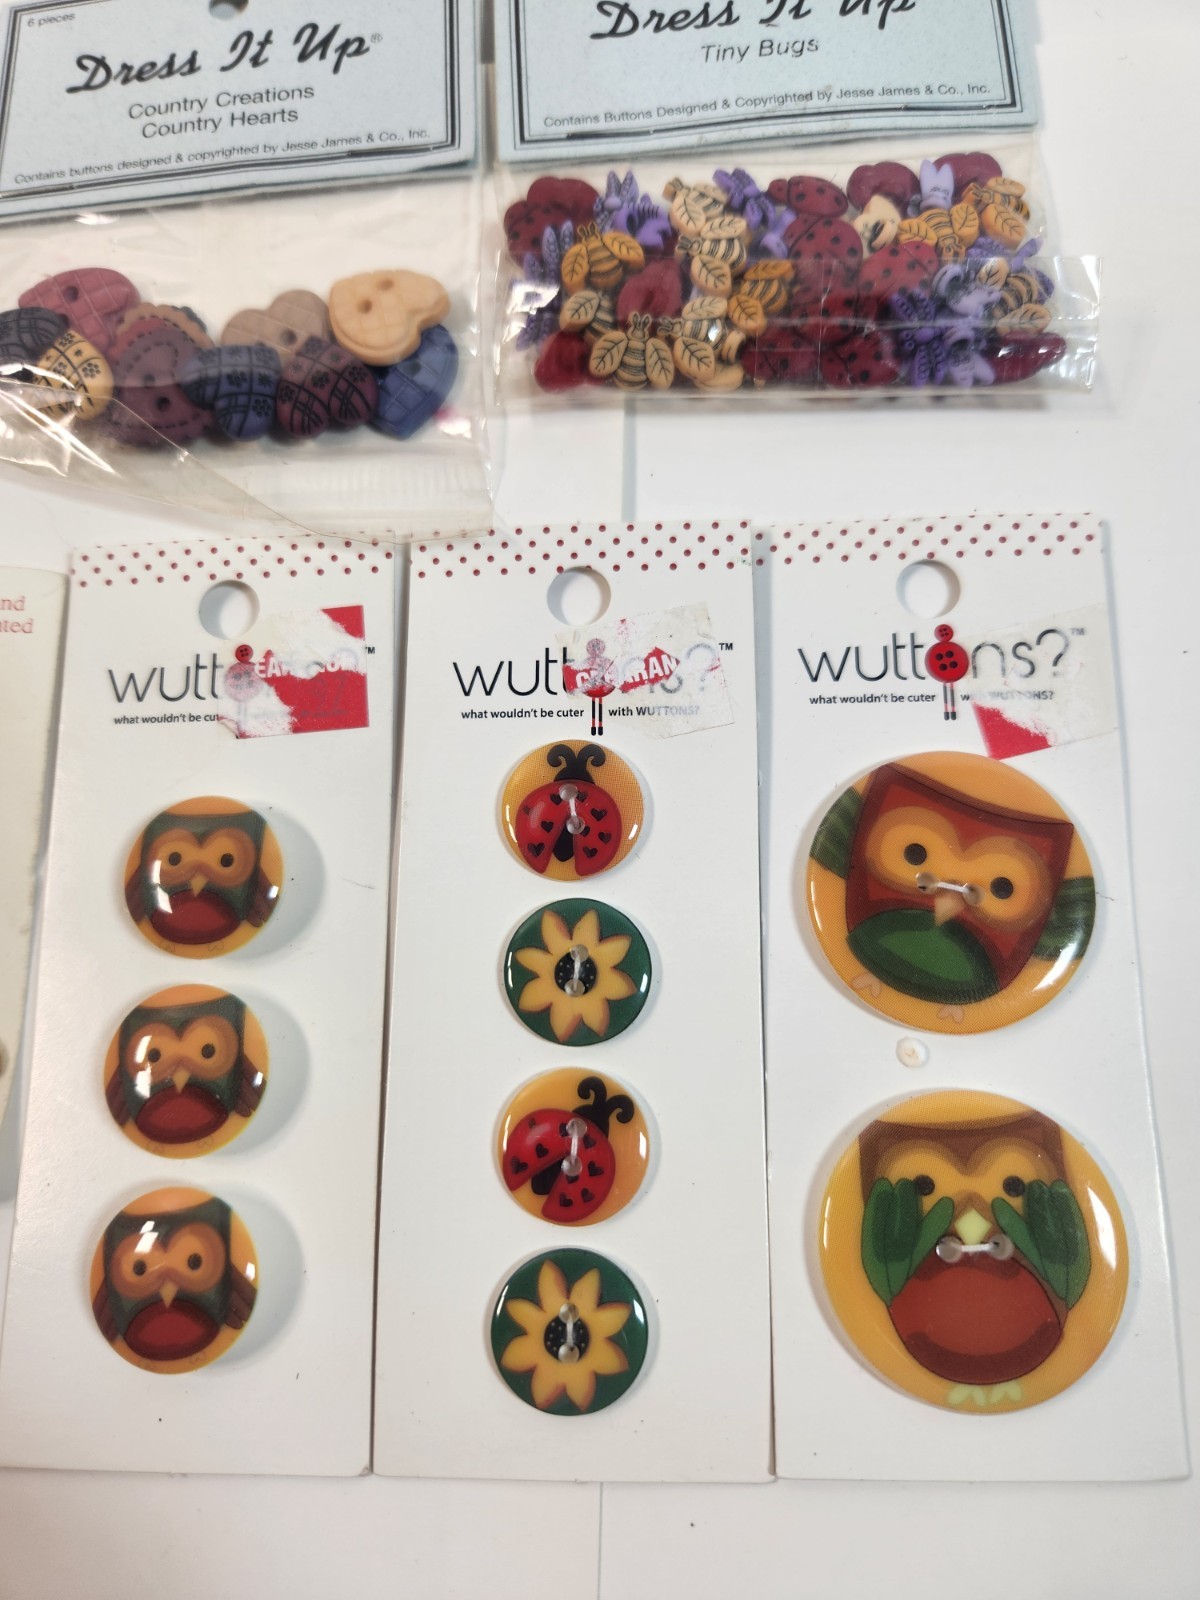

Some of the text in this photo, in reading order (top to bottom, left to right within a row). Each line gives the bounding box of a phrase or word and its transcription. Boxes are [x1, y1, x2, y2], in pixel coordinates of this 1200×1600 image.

[27, 12, 76, 27] 6 pieces
[589, 0, 740, 40] Dress
[66, 50, 201, 94] Dress
[219, 29, 273, 72] It
[700, 38, 819, 64] Tiny Bugs
[128, 86, 315, 120] Country Creations
[543, 83, 991, 128] Contains Buttons Designed & Copyrighted by Jesse James & Co., Inc.
[141, 107, 299, 139] Country Hearts
[14, 129, 431, 185] Contains buttons designed & copyrighted by Jesse James & Co., Inc.
[461, 705, 700, 719] what wouldn't be cuter with WUTTONS?
[809, 695, 837, 705] what
[840, 693, 888, 704] wouldn't
[891, 693, 905, 703] be
[907, 693, 936, 703] cuter
[114, 714, 139, 725] what
[142, 713, 186, 724] wouldn't
[188, 712, 202, 723] be
